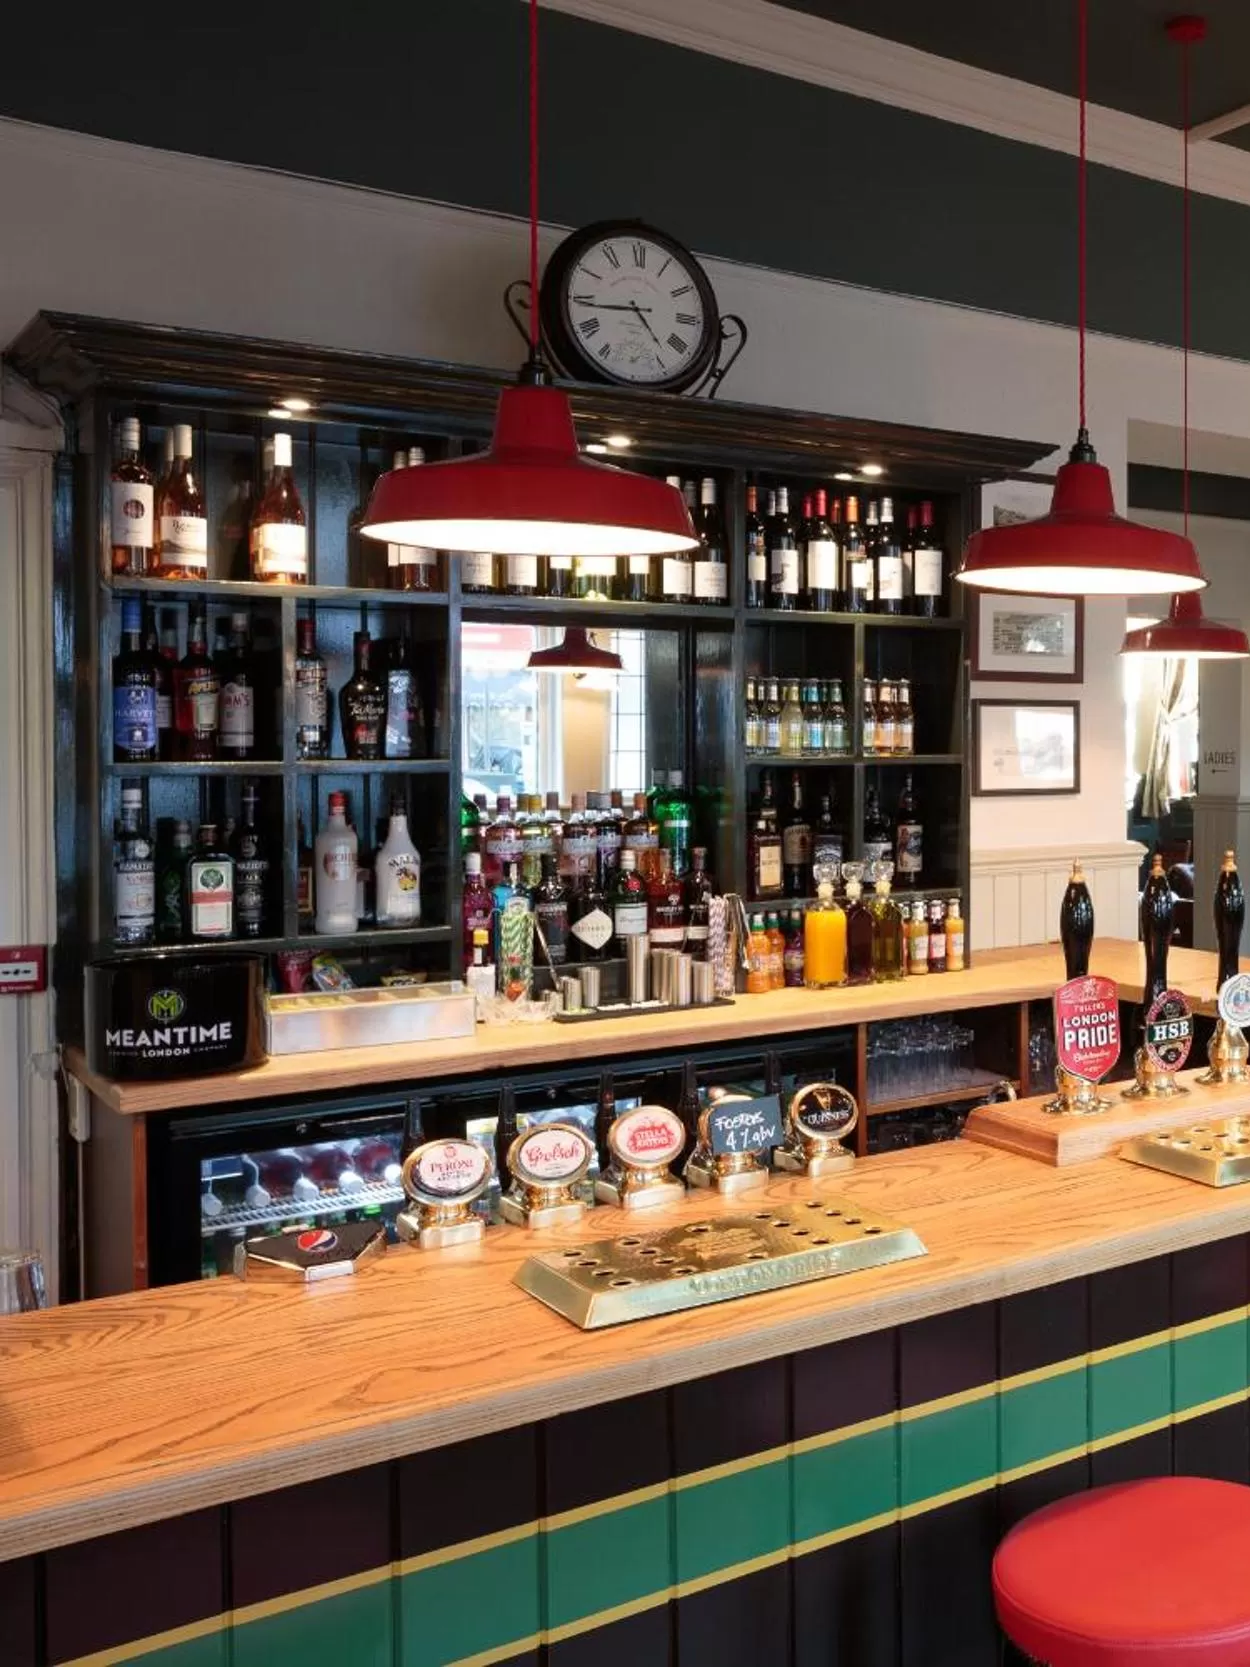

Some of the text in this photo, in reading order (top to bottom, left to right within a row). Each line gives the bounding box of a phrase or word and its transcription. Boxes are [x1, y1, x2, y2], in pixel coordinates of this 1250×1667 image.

[1203, 750, 1236, 765] LADIES
[1061, 1009, 1117, 1029] LONDON
[105, 1021, 233, 1048] MEANTIME
[1062, 1023, 1119, 1053] PRIDE
[1152, 1020, 1190, 1042] HSB
[141, 1047, 191, 1059] LONDON
[633, 1127, 667, 1140] STELLA
[525, 1140, 580, 1168] Grolsch
[429, 1159, 474, 1174] PERONI
